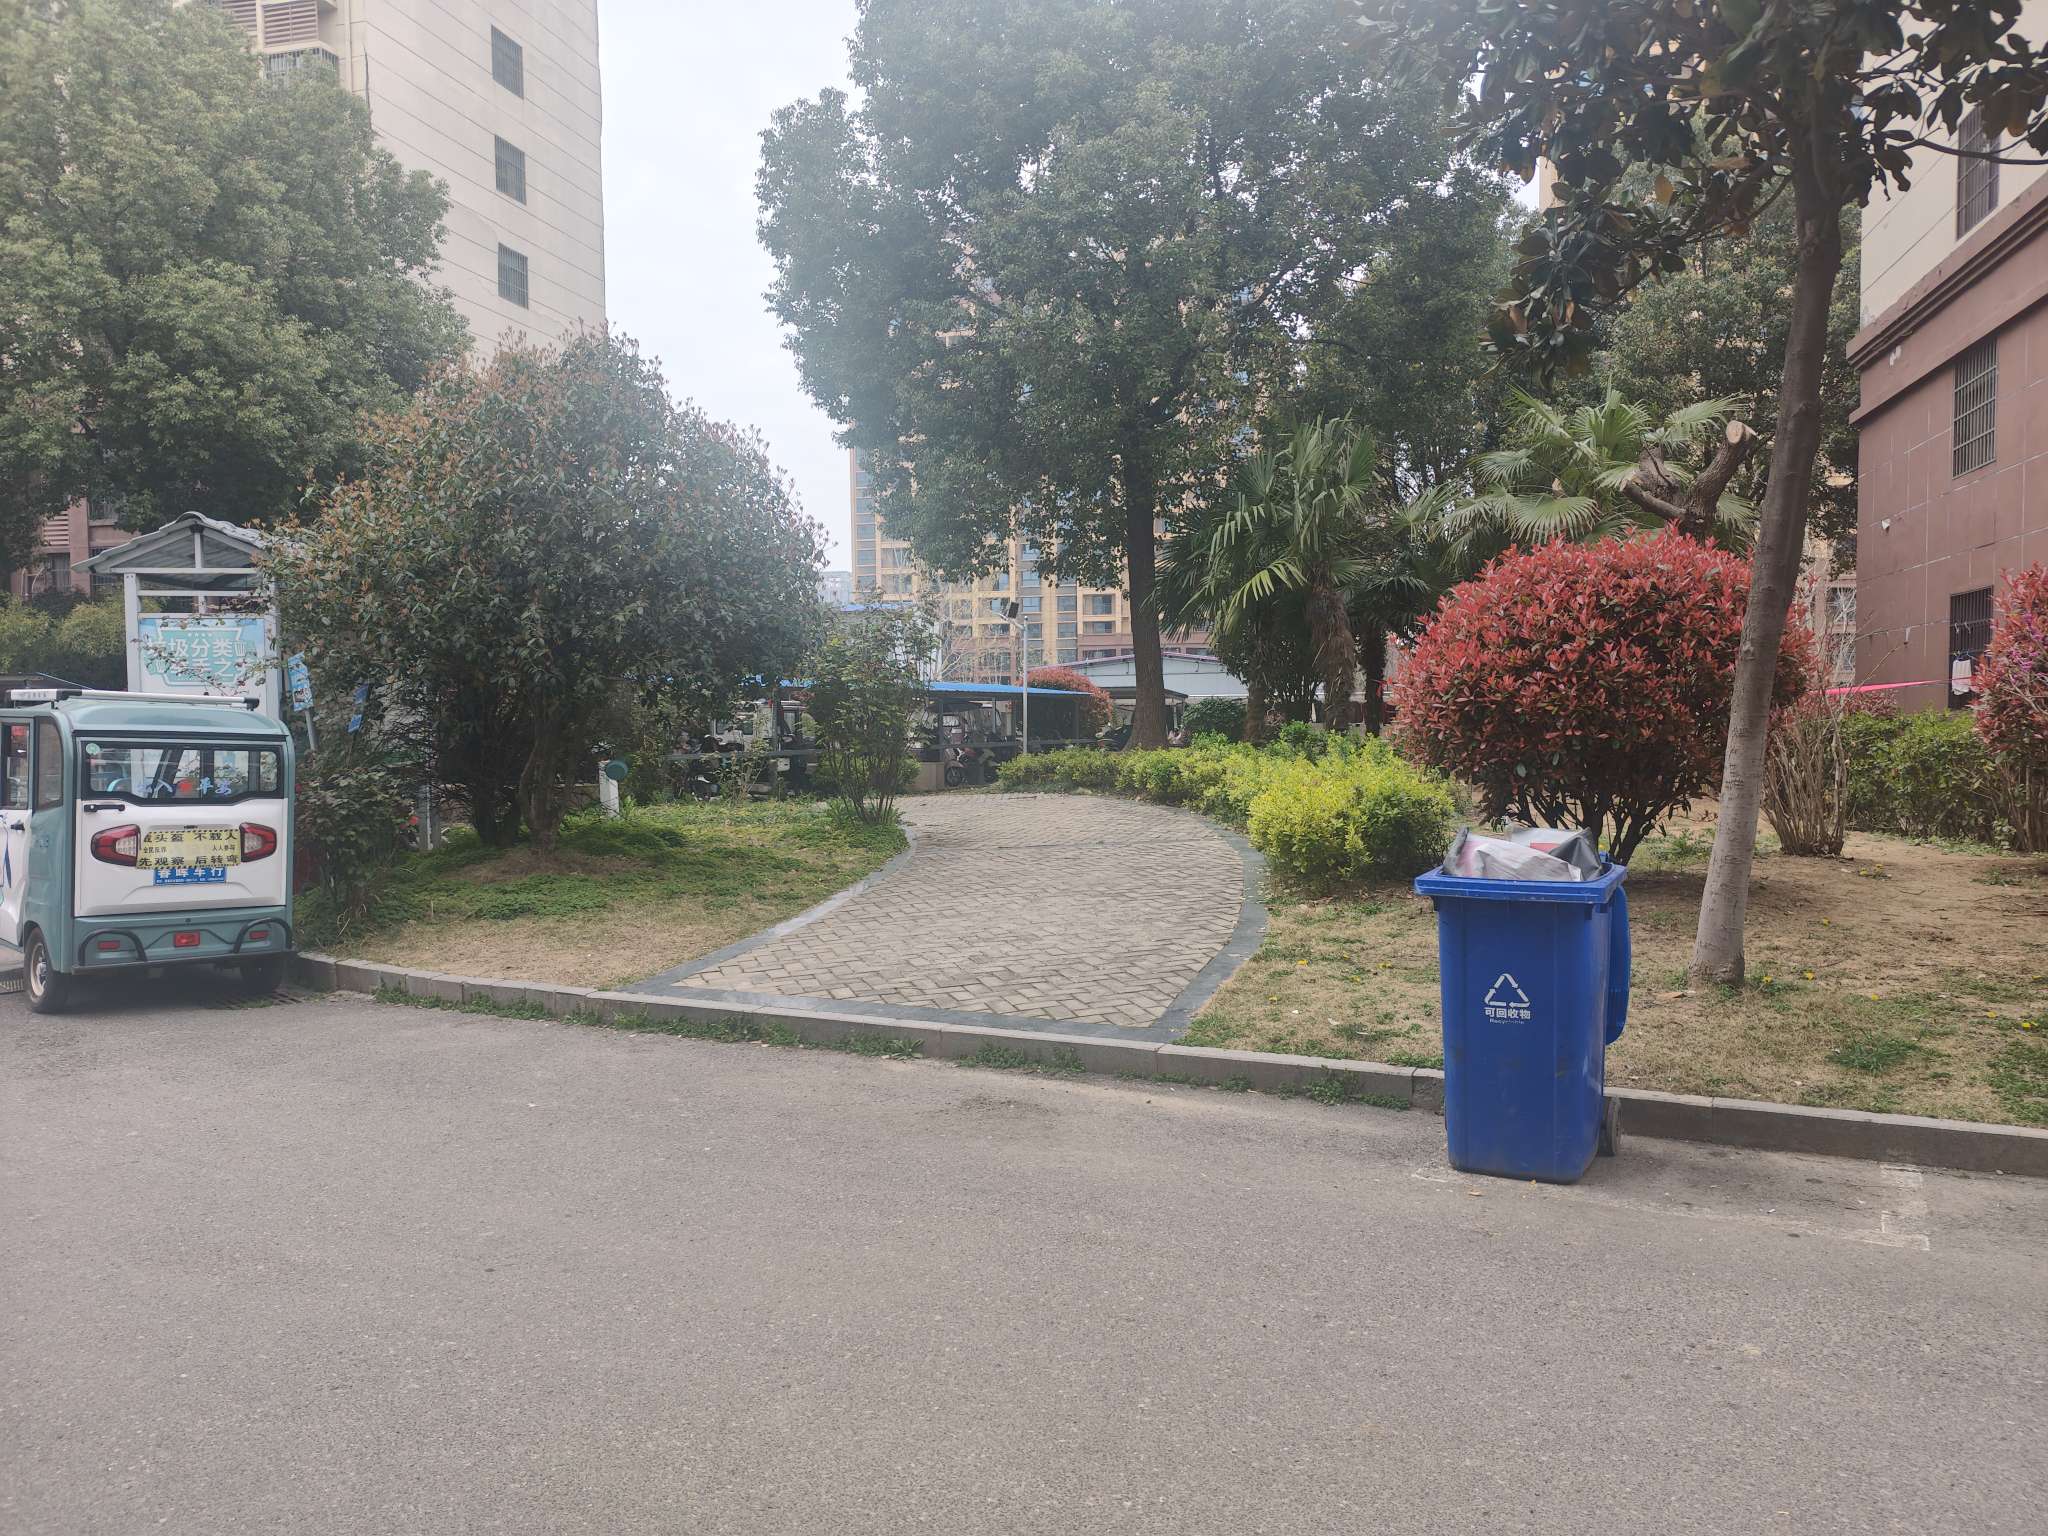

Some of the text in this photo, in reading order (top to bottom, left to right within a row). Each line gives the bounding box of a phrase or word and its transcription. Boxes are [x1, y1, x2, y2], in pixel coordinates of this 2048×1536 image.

[197, 776, 232, 795] 平安
[194, 831, 237, 842] 不载人
[139, 854, 239, 867] 先观察 后转弯
[1484, 1007, 1531, 1020] 可回收物
